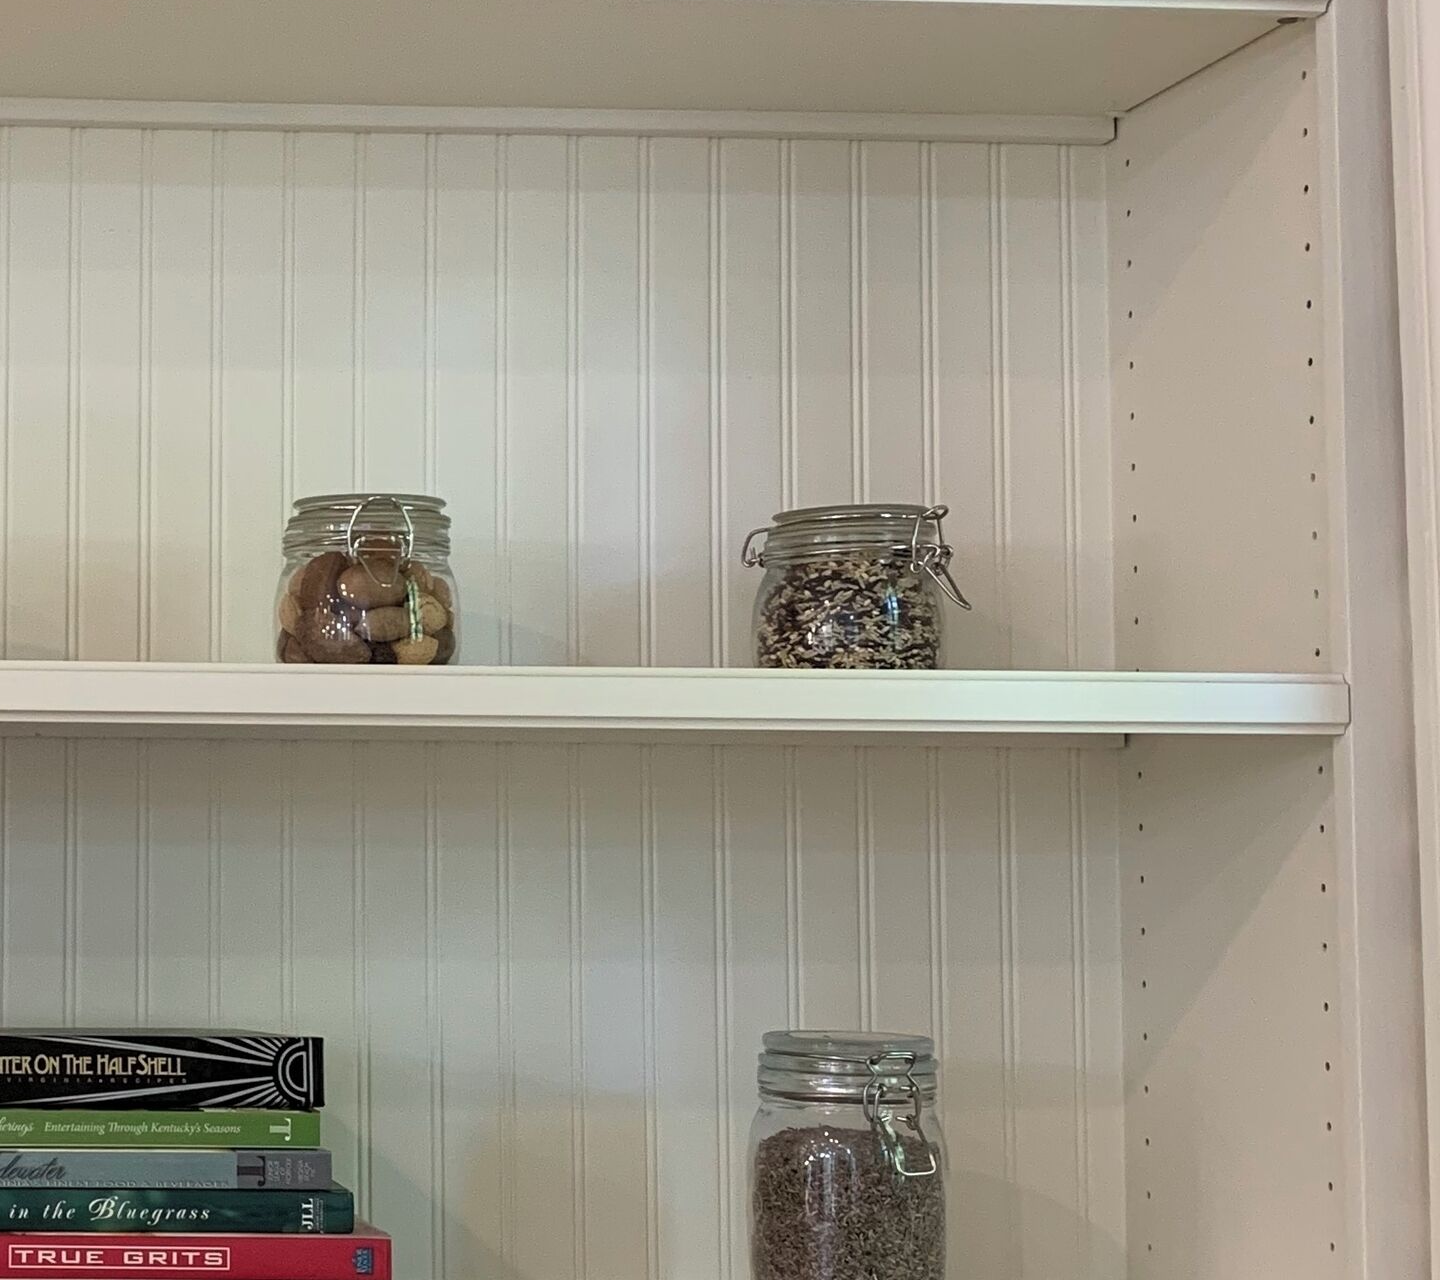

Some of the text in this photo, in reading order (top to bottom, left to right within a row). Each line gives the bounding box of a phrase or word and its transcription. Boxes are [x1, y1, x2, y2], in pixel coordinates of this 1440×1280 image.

[34, 1053, 59, 1075] ON
[62, 1054, 93, 1075] THE
[44, 1121, 106, 1135] Entertaining
[109, 1121, 149, 1136] Through
[151, 1122, 201, 1136] Kentucky's
[203, 1122, 241, 1134] Seasons
[9, 1204, 29, 1220] in
[42, 1200, 76, 1220] the
[88, 1195, 211, 1226] Bluegrass
[301, 1198, 314, 1230] JLL
[14, 1249, 225, 1266] TRUE GRITS
